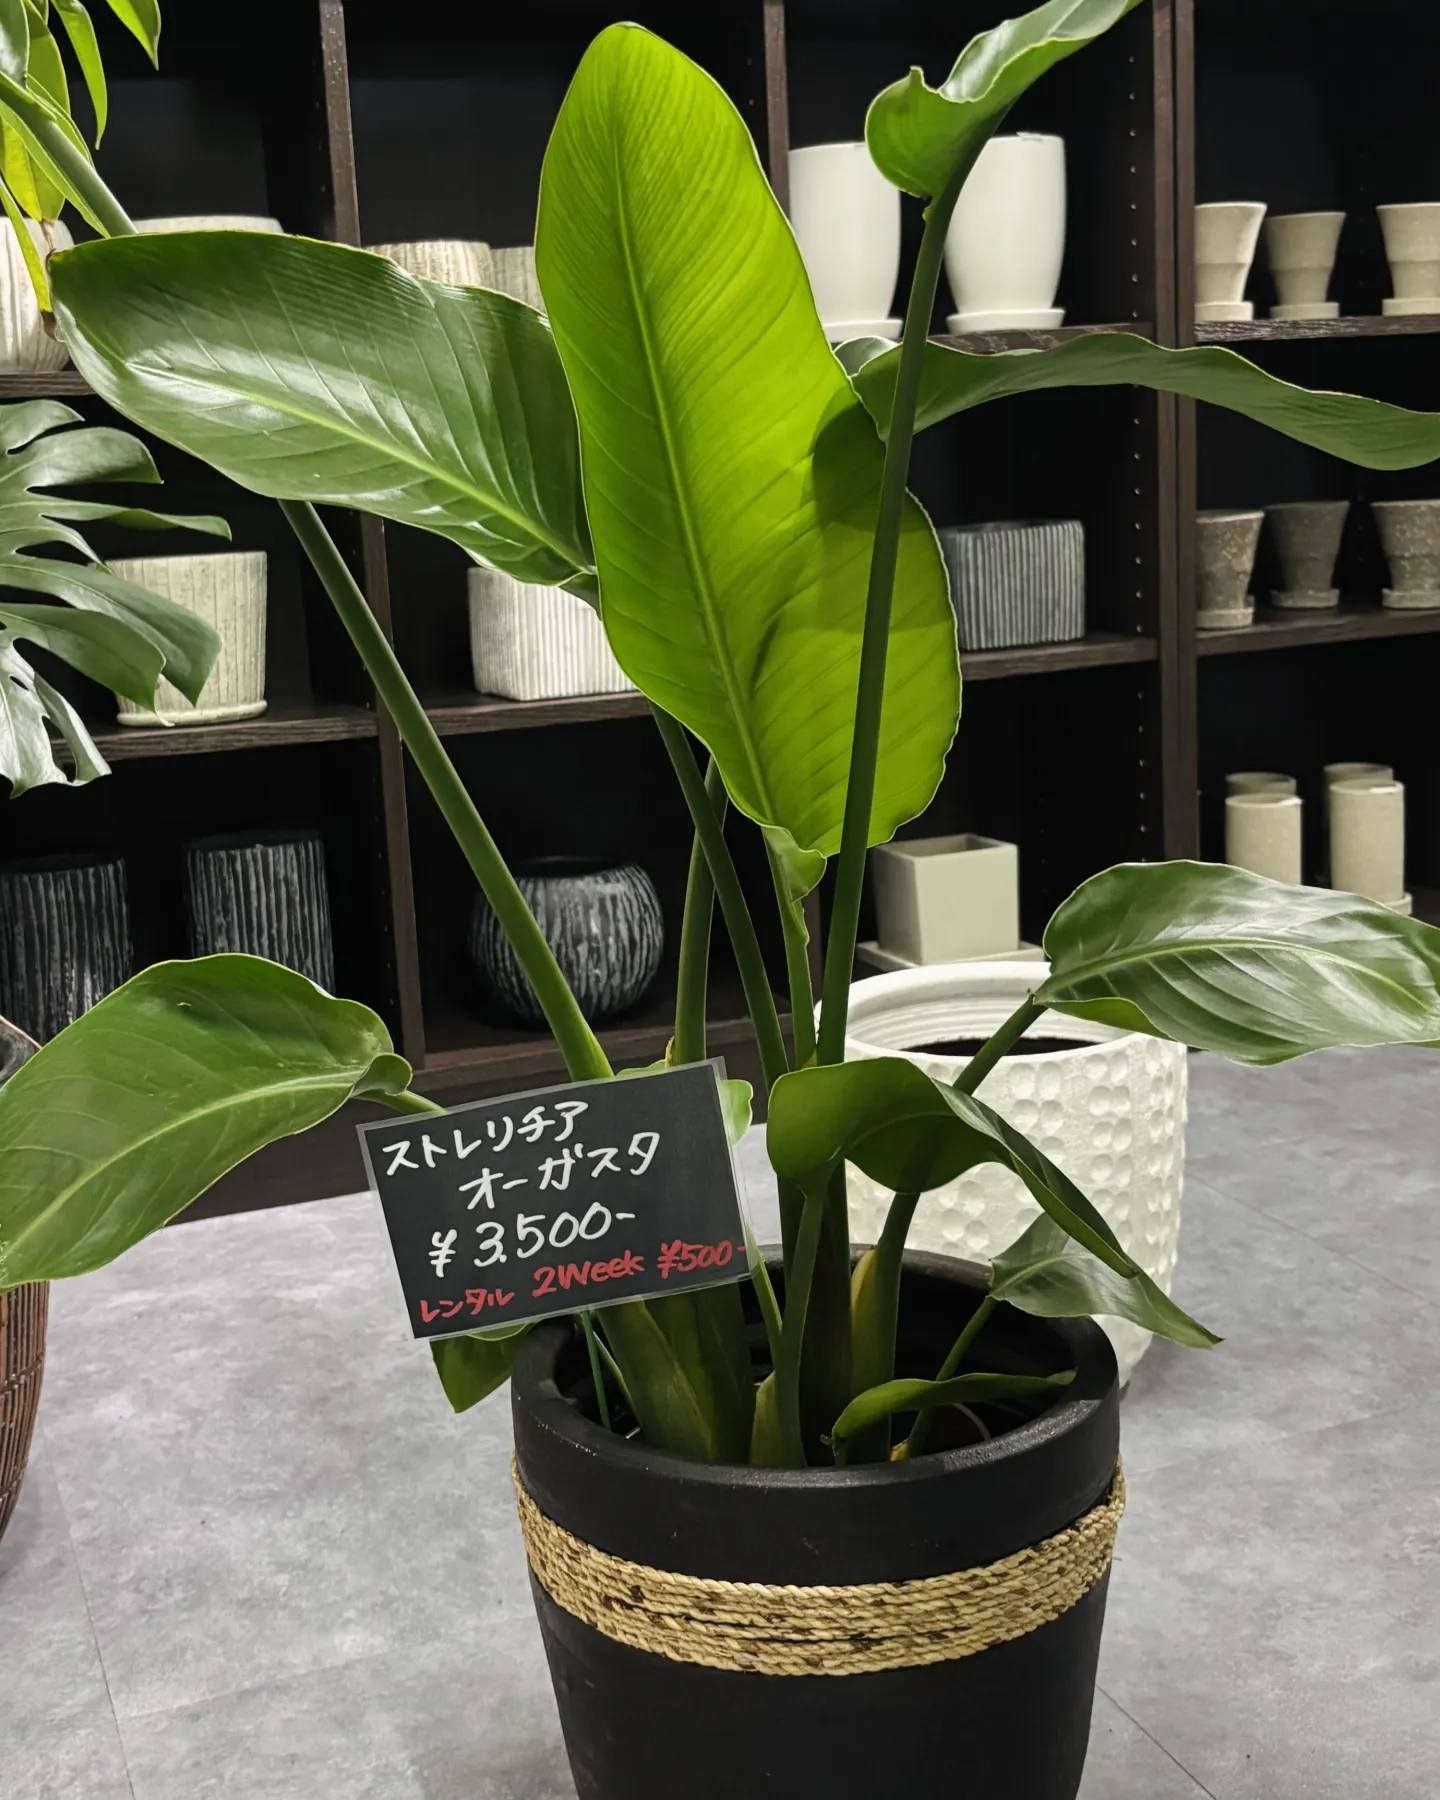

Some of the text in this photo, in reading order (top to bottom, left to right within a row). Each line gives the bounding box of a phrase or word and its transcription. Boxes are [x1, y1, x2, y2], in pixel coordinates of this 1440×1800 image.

[382, 1101, 588, 1176] ストレリチア
[458, 1131, 660, 1210] オーガスタ
[419, 1288, 515, 1323] レンタル
[532, 1249, 644, 1298] 2Week
